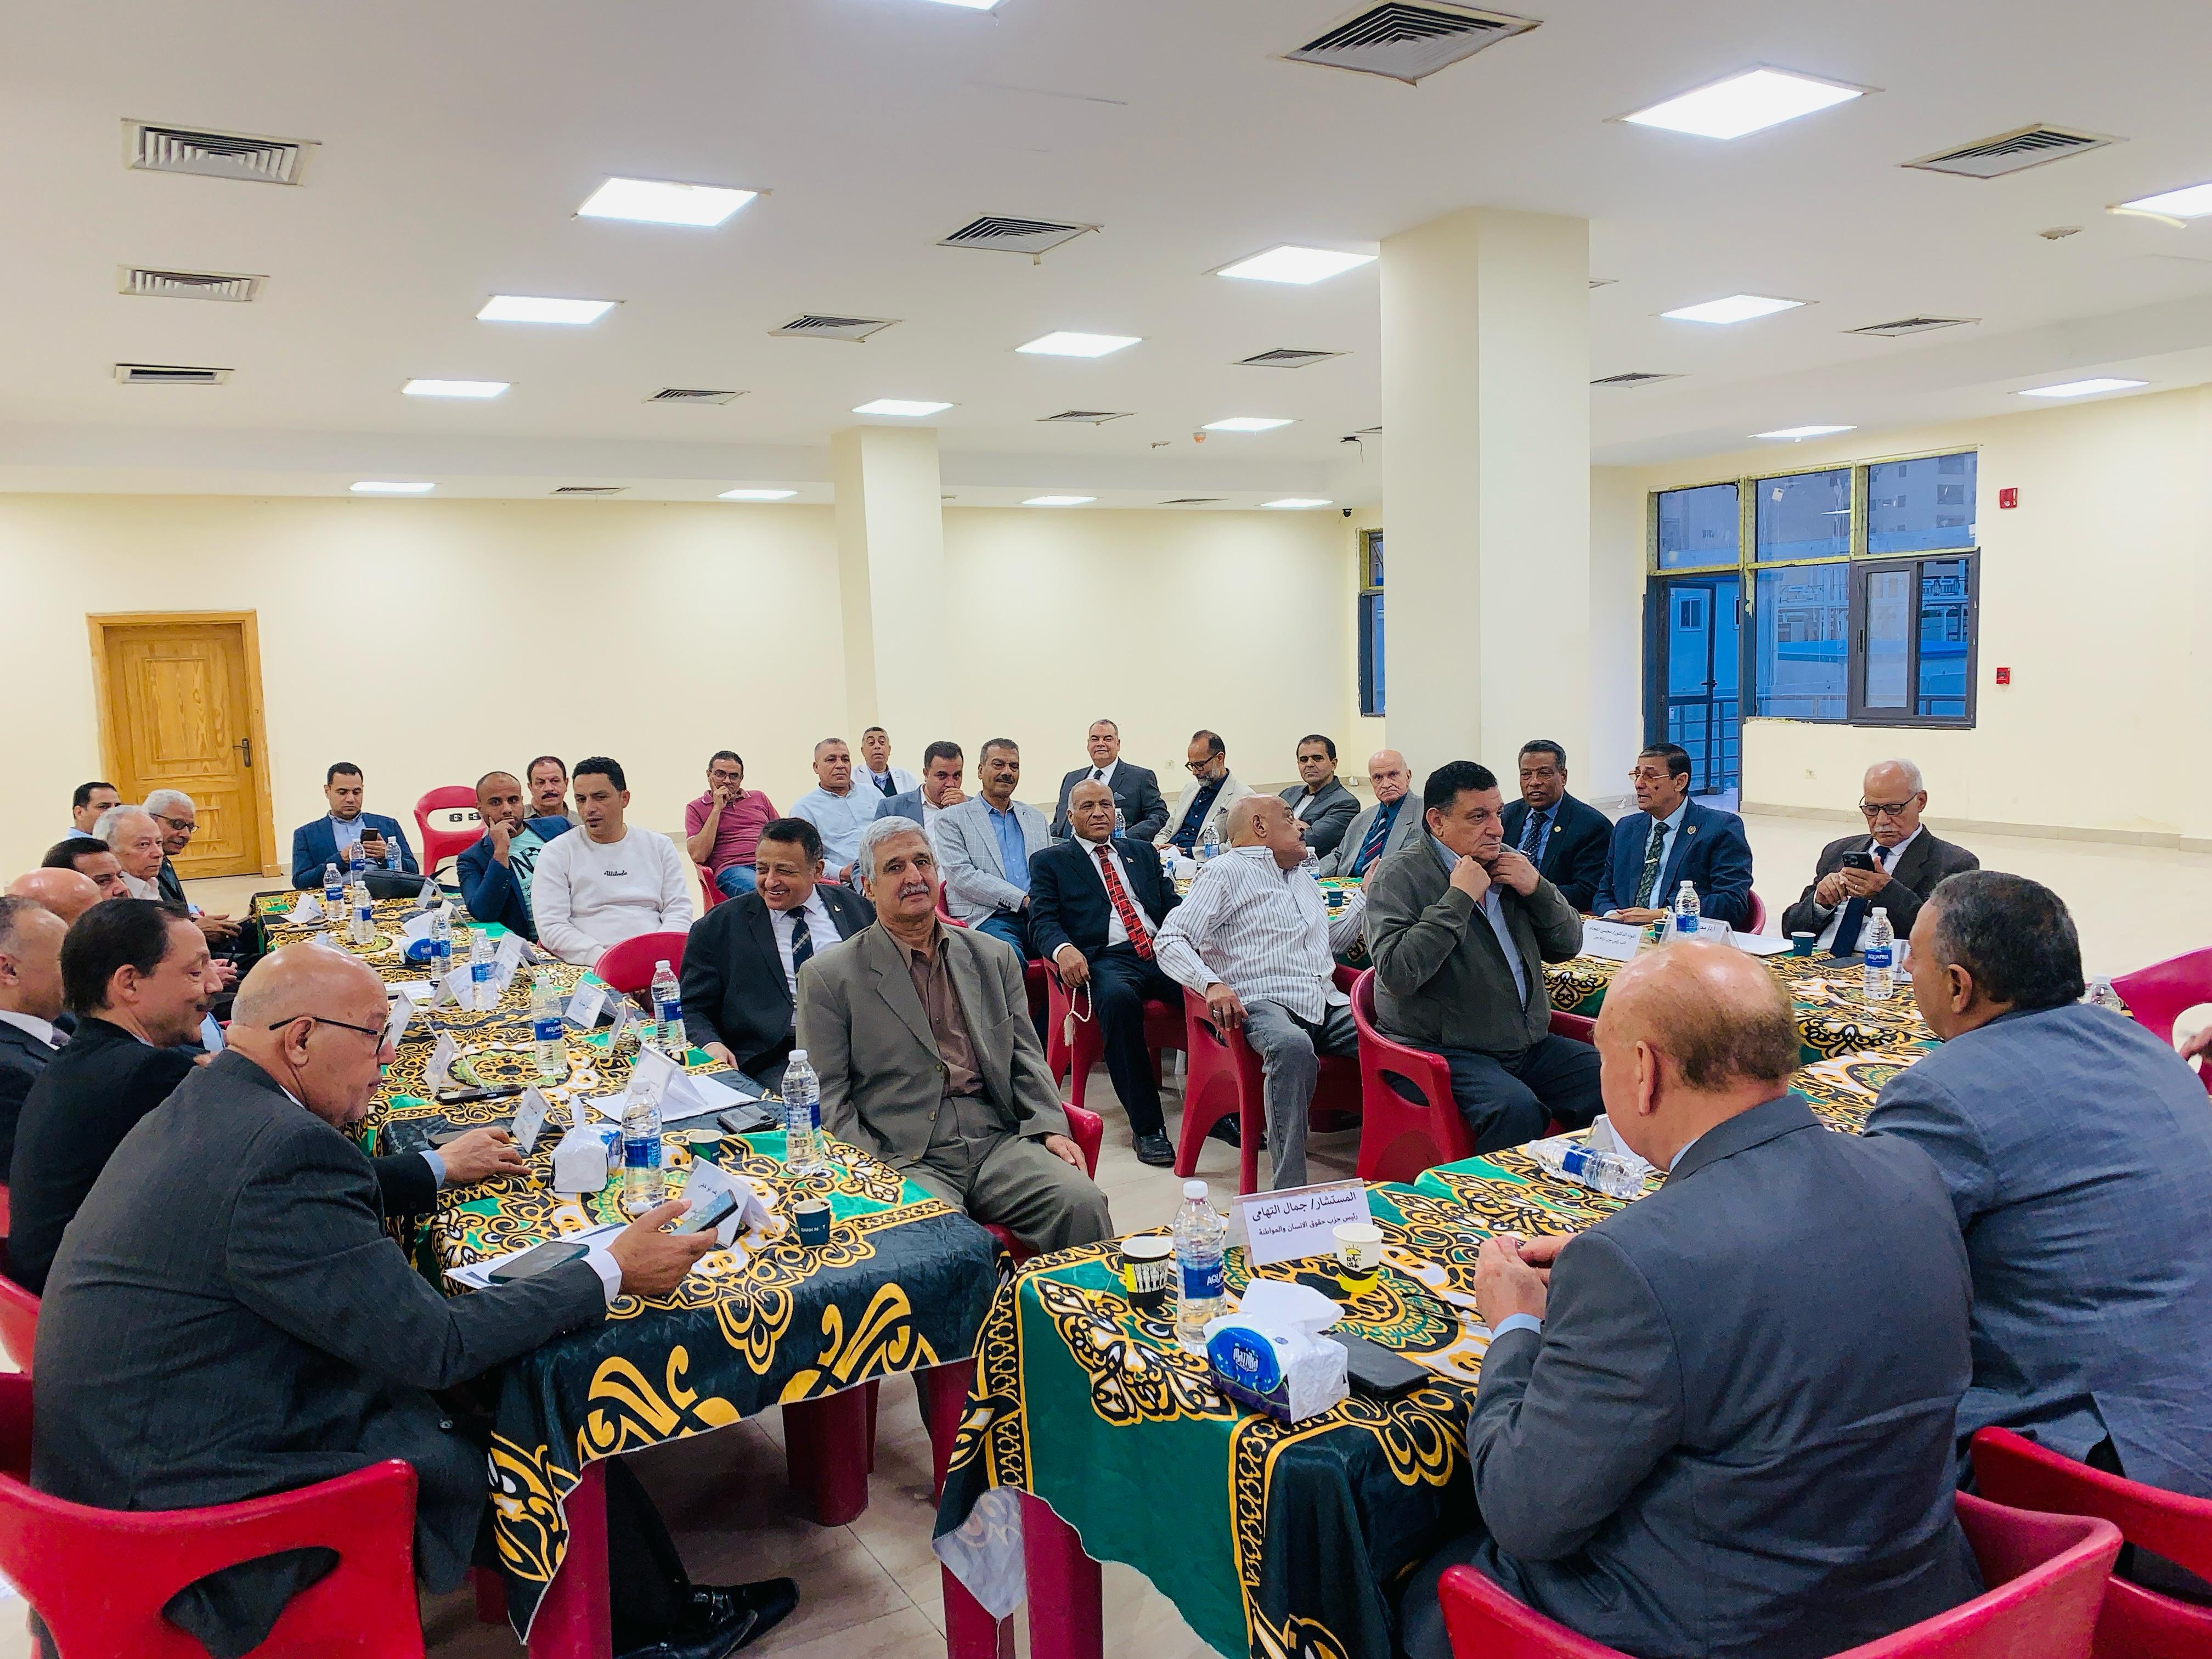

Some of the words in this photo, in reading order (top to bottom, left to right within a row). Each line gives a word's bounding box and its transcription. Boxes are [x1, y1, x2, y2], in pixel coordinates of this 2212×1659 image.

[1283, 1201, 1307, 1215] جمال
[1309, 1218, 1326, 1228] حقوق
[1327, 1216, 1341, 1224] حزب
[1342, 1212, 1358, 1223] رئيس
[1259, 1225, 1286, 1236] والمواطنة
